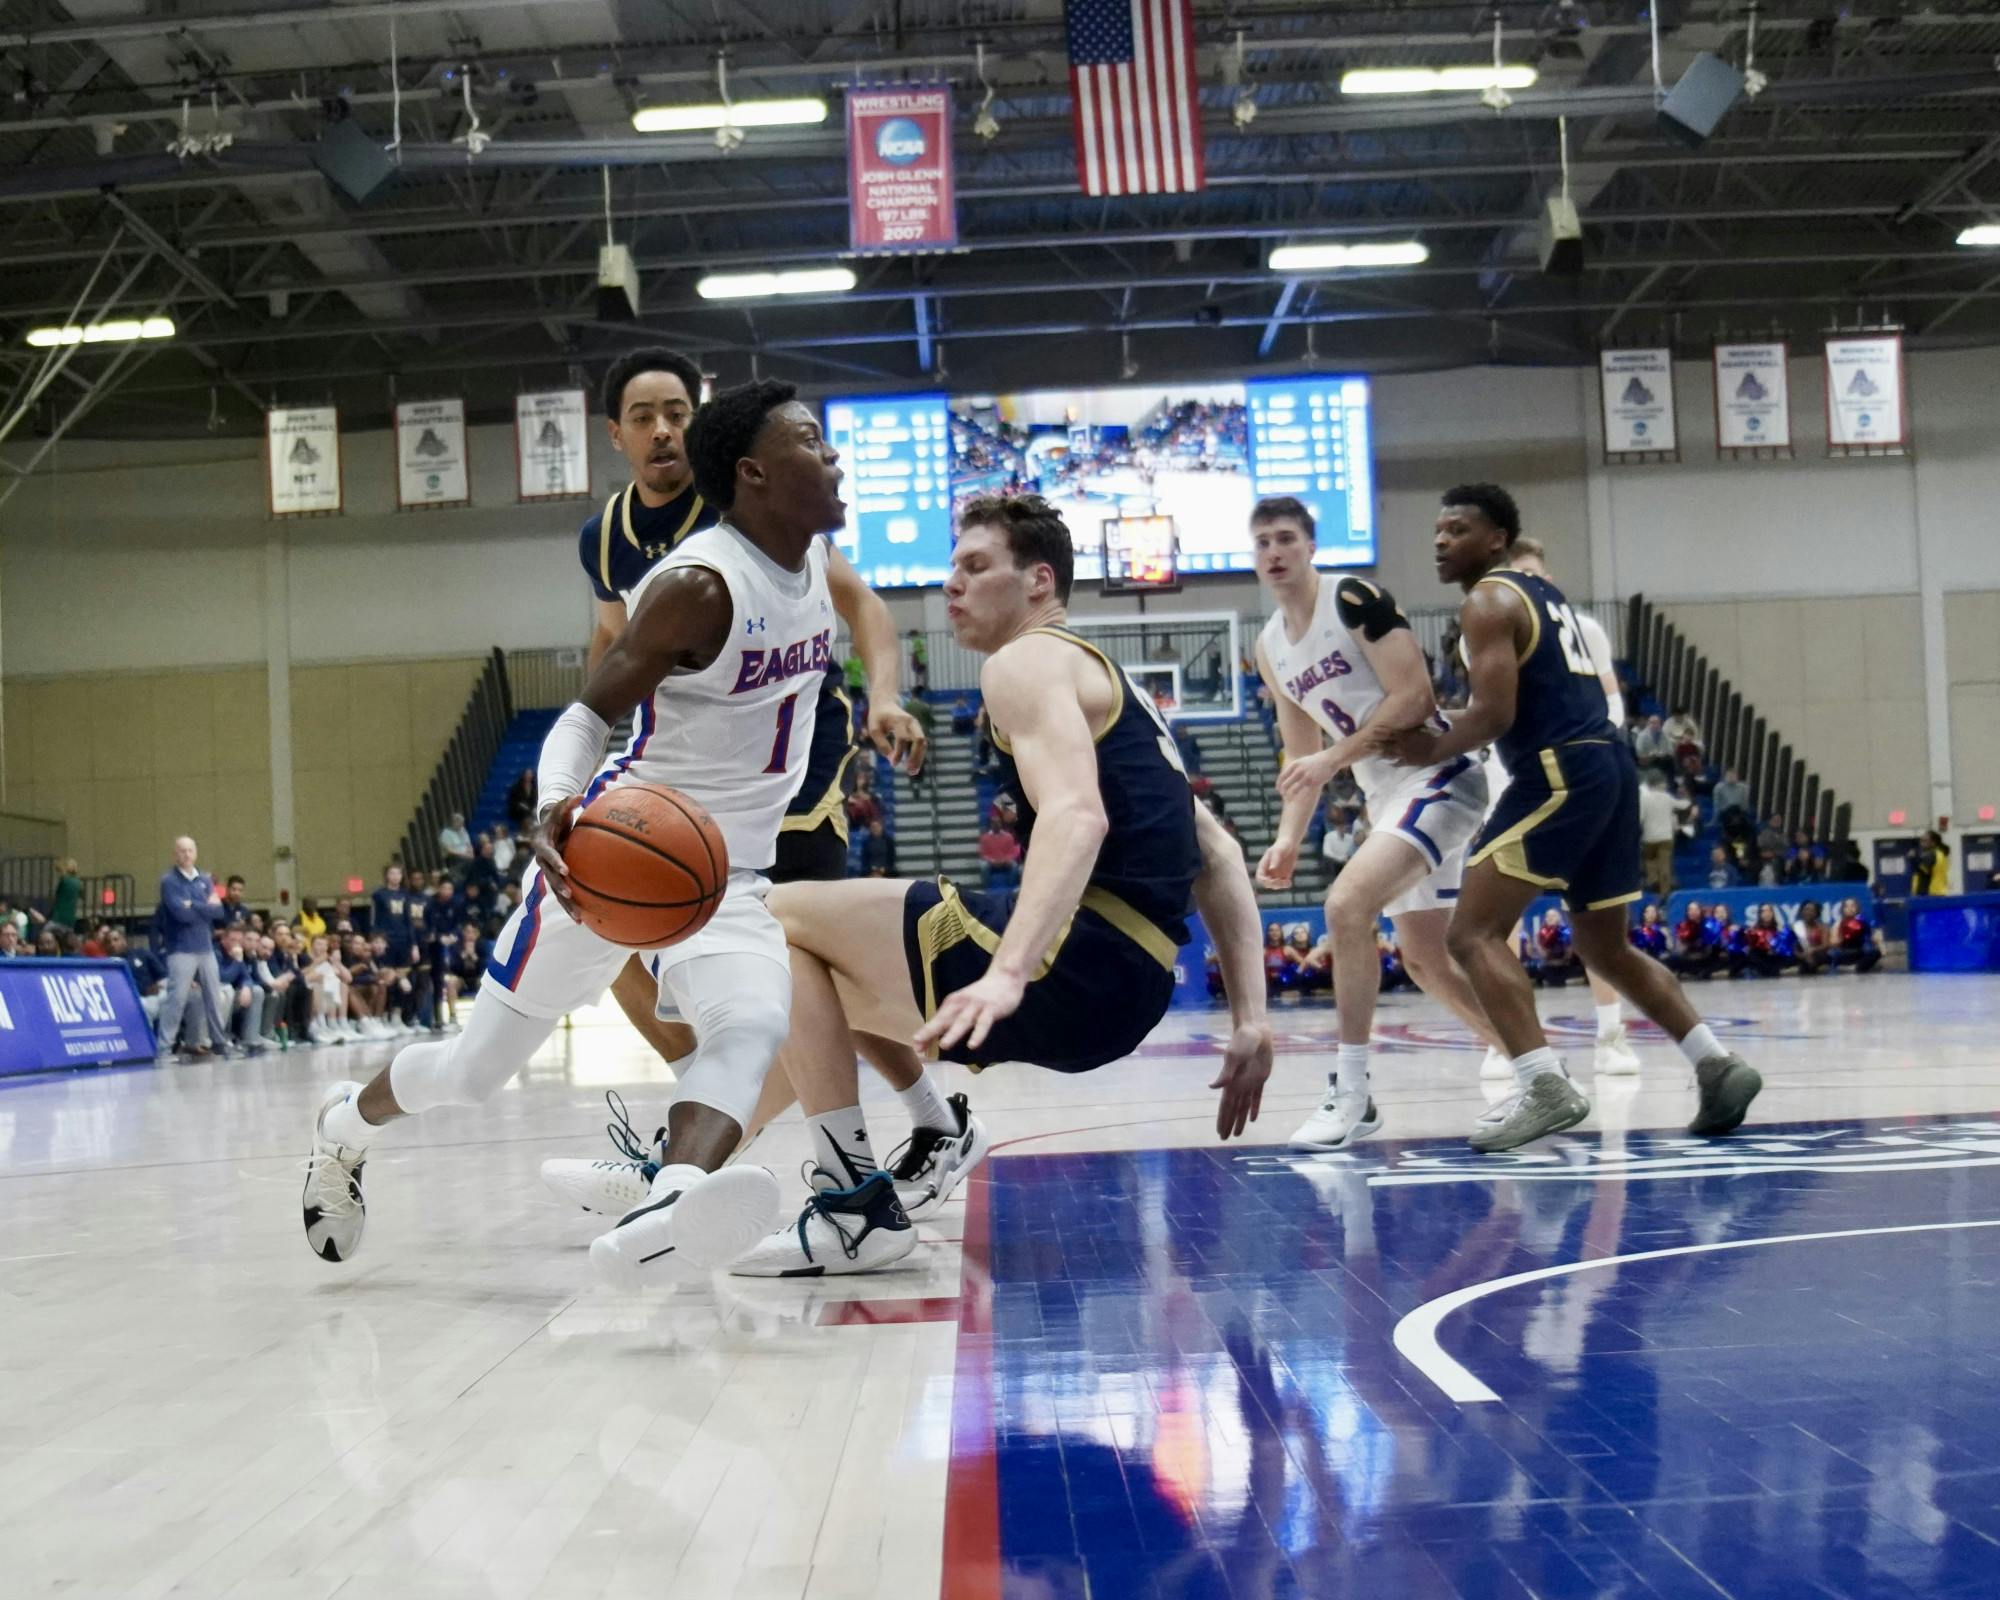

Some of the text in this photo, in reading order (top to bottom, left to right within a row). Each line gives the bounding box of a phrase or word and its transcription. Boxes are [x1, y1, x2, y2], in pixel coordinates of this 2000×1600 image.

[853, 94, 944, 110] WRESTLING
[866, 195, 939, 209] CHAMPION
[868, 184, 935, 197] NATIONAL
[883, 225, 925, 241] 2007
[728, 629, 833, 695] EAGLES
[1286, 650, 1353, 704] EAGLES
[1321, 698, 1357, 737] 8
[761, 693, 799, 774] 1
[41, 973, 84, 1024] ALL
[77, 974, 116, 1022] SET
[64, 1040, 108, 1056] RESTAURANT
